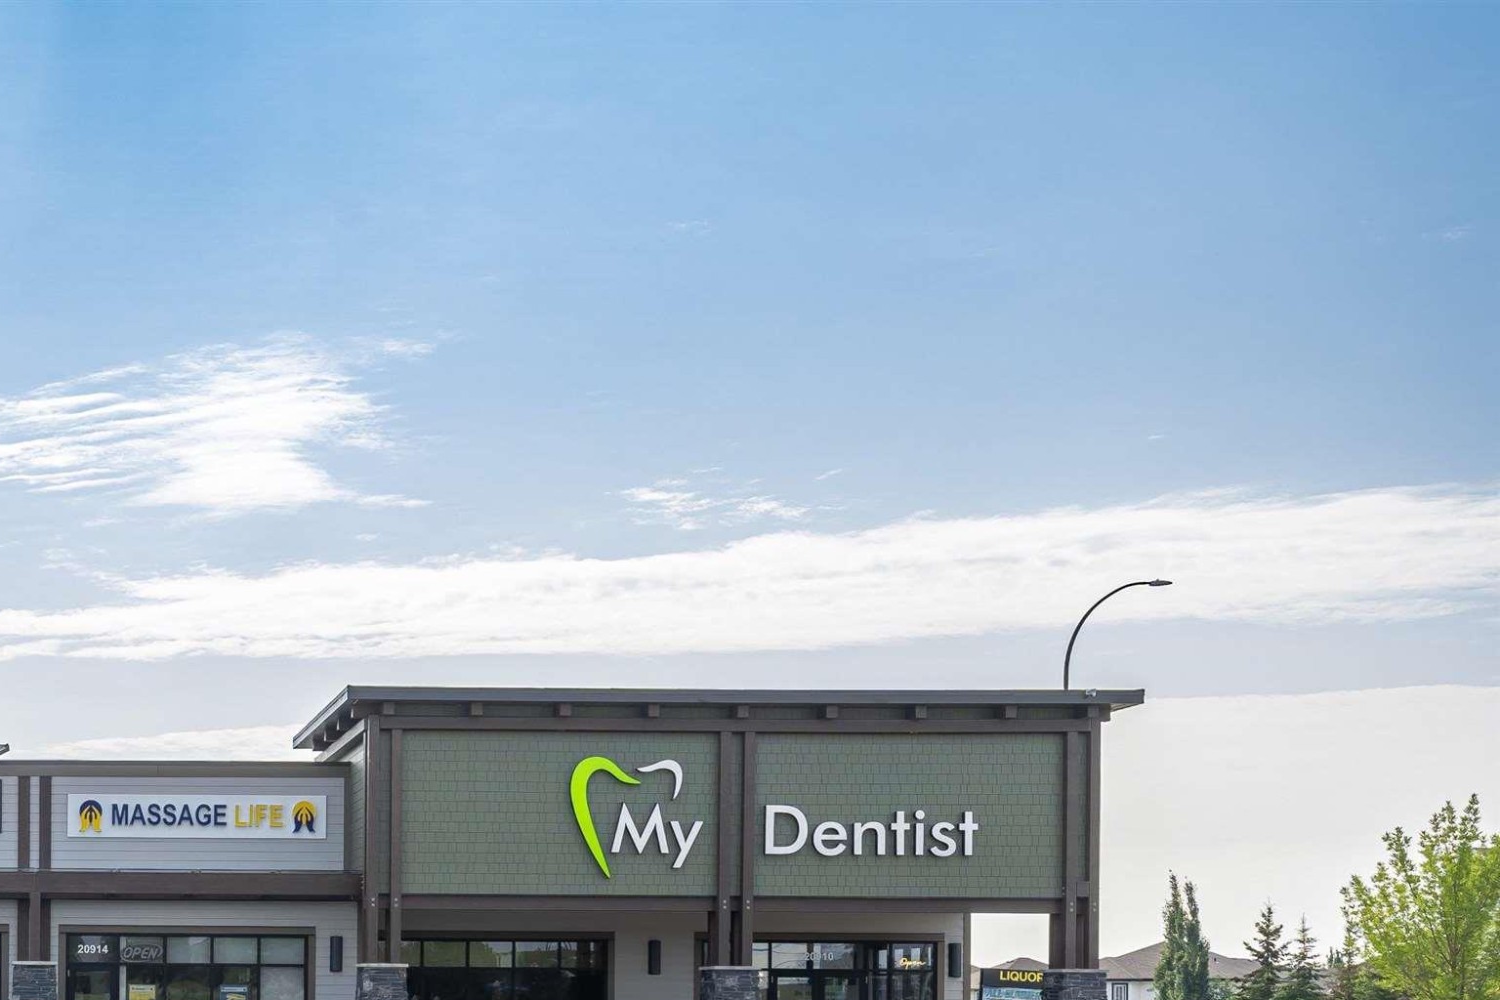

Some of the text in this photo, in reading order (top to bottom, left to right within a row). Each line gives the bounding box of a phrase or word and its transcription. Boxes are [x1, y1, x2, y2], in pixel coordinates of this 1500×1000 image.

[110, 803, 284, 828] MASSAGE LIFE
[610, 801, 979, 869] My Dentist
[77, 944, 109, 954] 20914
[122, 946, 160, 959] OPEN
